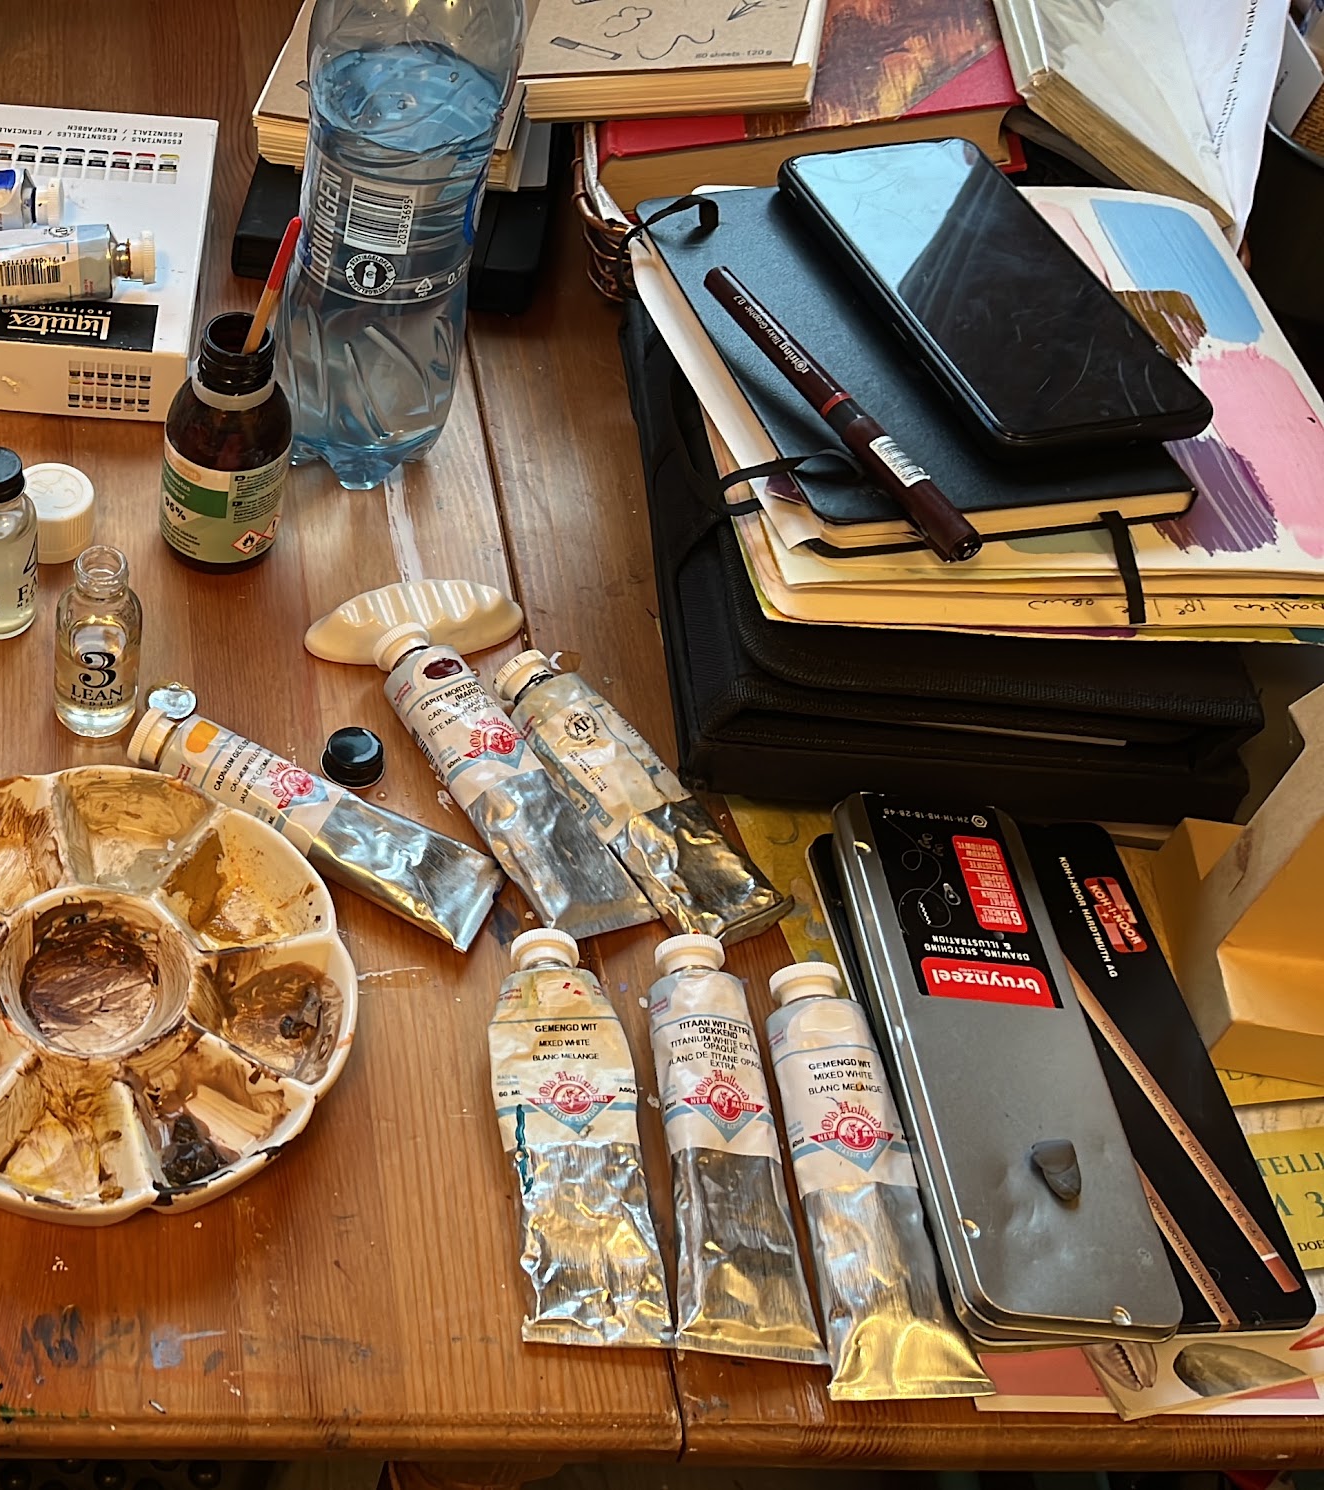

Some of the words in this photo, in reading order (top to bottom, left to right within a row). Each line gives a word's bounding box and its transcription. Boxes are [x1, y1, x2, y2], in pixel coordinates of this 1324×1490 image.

[1230, 61, 1242, 84] jou
[56, 131, 117, 141] ESSENTIELLES
[67, 125, 119, 133] KERNFARBEN
[132, 129, 183, 137] ESSENZIALI
[131, 136, 183, 145] ESSENTIALS
[401, 198, 414, 220] 3695
[308, 166, 342, 281] LÖNINGEN
[398, 222, 410, 245] 2038
[9, 309, 111, 340] Liquitex
[745, 305, 768, 329] Graphic
[778, 341, 810, 374] rotring
[79, 651, 116, 688] 3
[71, 684, 123, 700] LEAN
[70, 694, 123, 706] MEDIUM
[421, 694, 443, 710] CAPUT
[428, 706, 451, 721] CAPUT
[428, 723, 445, 738] TÊTE
[214, 756, 235, 791] CADMIUM
[1012, 910, 1023, 926] 6
[1058, 856, 1087, 907] KOH-I-NOOR
[1081, 908, 1111, 962] HARDTMUTH
[1106, 964, 1118, 977] AG
[1089, 884, 1142, 945] KOH-I-NOOR
[932, 934, 1000, 949] ILLUSTRATION
[924, 943, 978, 956] SKETCHING
[980, 951, 1030, 961] DRAWING,
[931, 969, 1042, 994] bruynzeel
[534, 1024, 579, 1032] GEMENGD
[581, 1023, 598, 1031] WIT
[678, 1019, 711, 1030] TITAAN
[712, 1019, 727, 1029] WIT
[698, 1026, 738, 1040] DEKKEND
[539, 1039, 564, 1047] MIXED
[671, 1035, 712, 1048] TITANIUM
[712, 1036, 738, 1047] WHITE
[703, 1041, 738, 1054] OPAQUE
[695, 1052, 709, 1060] DE
[710, 1052, 739, 1064] TITANE
[709, 1060, 737, 1071] EXTRA
[808, 1058, 857, 1071] GEMENGD
[858, 1060, 871, 1069] WIT
[814, 1070, 843, 1081] MIXED
[845, 1070, 874, 1080] WHITE
[538, 1081, 557, 1097] Old
[555, 1071, 599, 1095] Holland
[695, 1077, 713, 1096] Old
[712, 1070, 749, 1100] Holland
[808, 1084, 840, 1095] BLANC
[842, 1083, 883, 1094] MELANGE
[731, 1101, 758, 1112] MASTERS
[821, 1111, 838, 1130] Old
[838, 1101, 882, 1129] Holland
[817, 1132, 836, 1142] NEW
